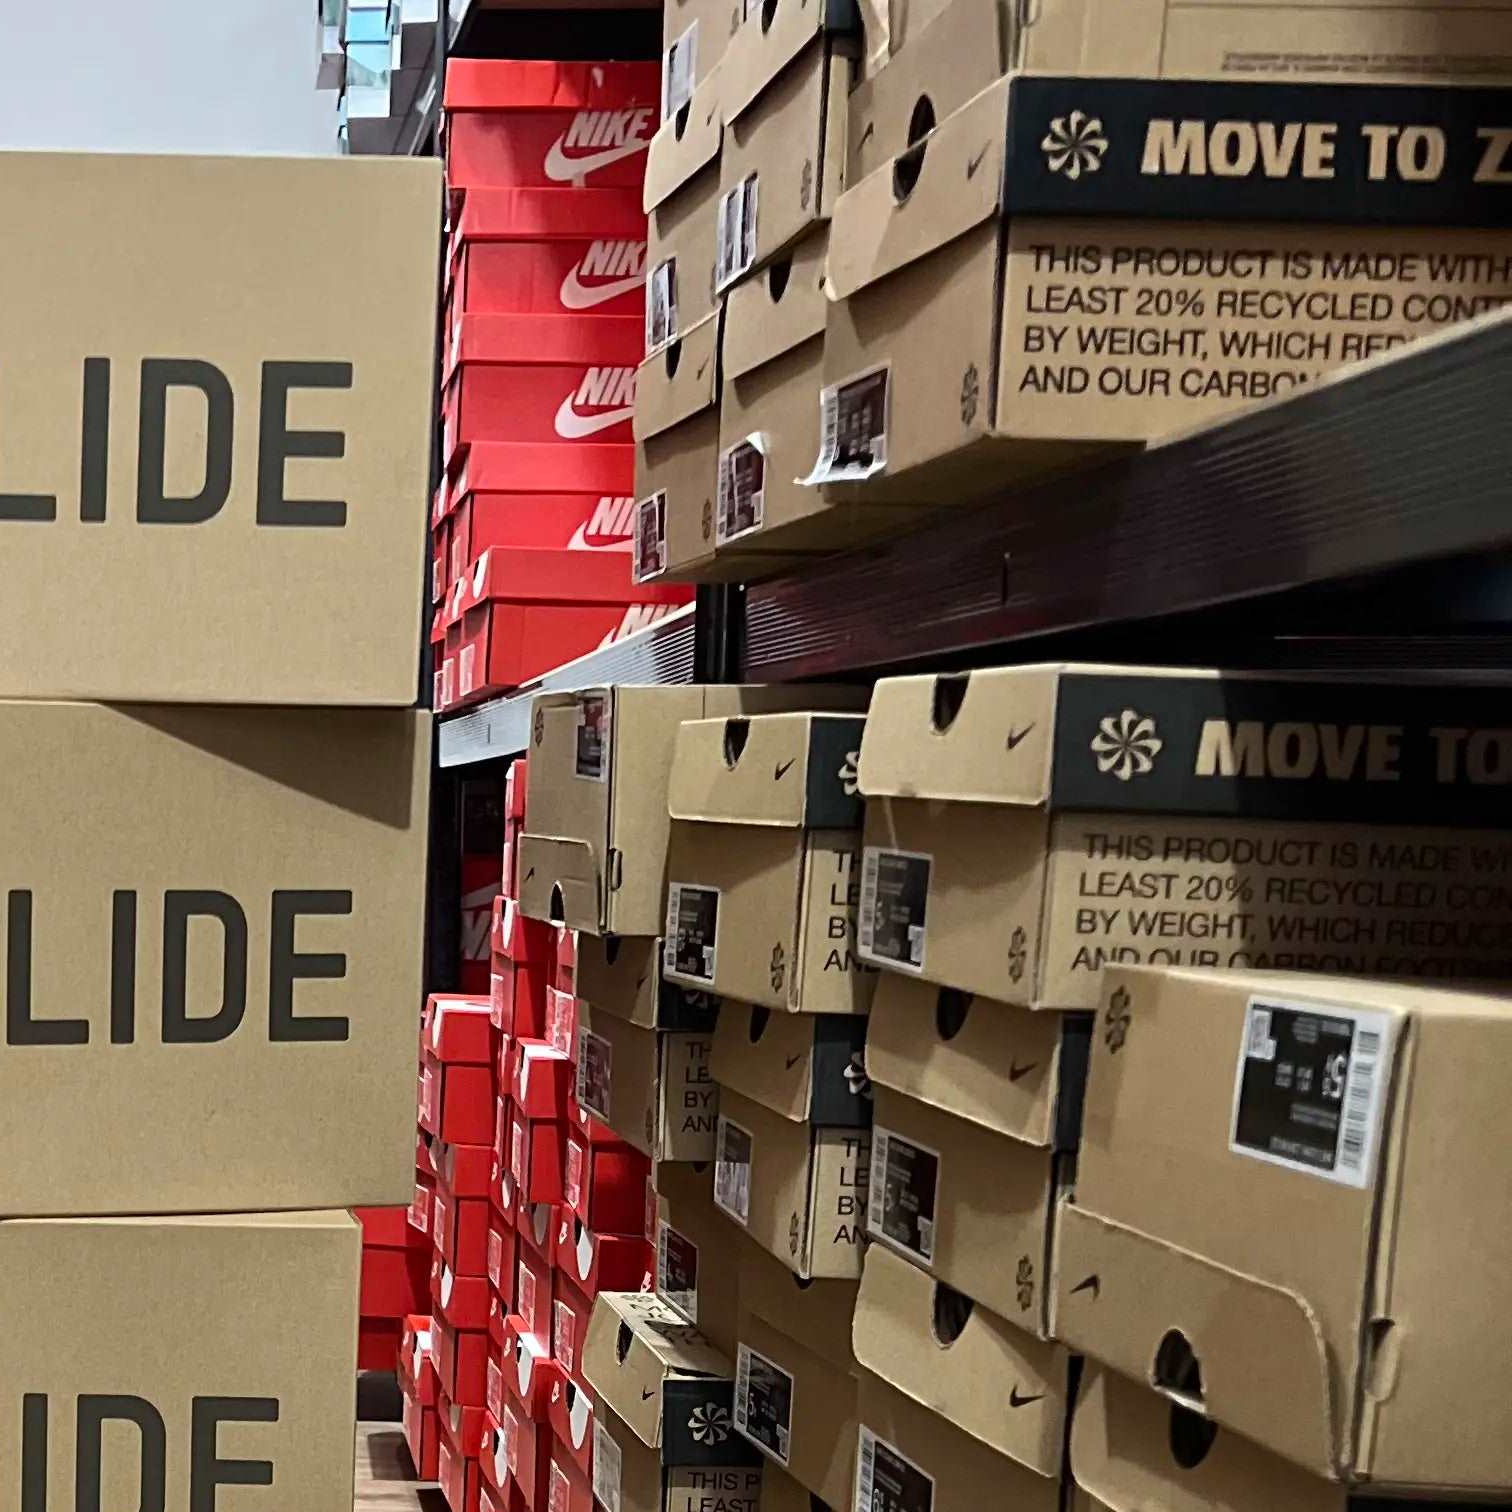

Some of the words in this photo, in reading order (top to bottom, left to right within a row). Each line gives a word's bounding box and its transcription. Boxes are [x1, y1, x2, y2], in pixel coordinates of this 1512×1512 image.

[564, 108, 655, 148] NIKE
[1141, 119, 1338, 180] MOVE
[1360, 125, 1446, 181] TO
[579, 240, 648, 276] NIK
[1028, 244, 1102, 275] THIS
[1111, 246, 1274, 279] PRODUCT
[1282, 251, 1312, 280] IS
[1321, 252, 1423, 282] MADE
[1026, 285, 1129, 315] LEAST
[1135, 287, 1205, 319] 20%
[1217, 290, 1393, 322] RECYCLED
[1023, 325, 1068, 354] BY
[1077, 327, 1209, 362] WEIGHT,
[1219, 330, 1330, 361] WHICH
[1019, 365, 1090, 395] AND
[1098, 367, 1171, 396] OUR
[1195, 719, 1404, 781] MOVE
[1083, 833, 1153, 861] THIS
[1162, 836, 1322, 866] PRODUCT
[1329, 841, 1358, 868] IS
[1368, 843, 1462, 872] MADE
[1078, 872, 1180, 900] LEAST
[1185, 875, 1253, 903] 20%
[1265, 877, 1437, 908] RECYCLED
[1075, 908, 1121, 935] BY
[1128, 910, 1257, 944] WEIGHT,
[1268, 914, 1376, 944] WHICH
[1071, 946, 1142, 971] AND
[687, 1471, 739, 1491] THIS
